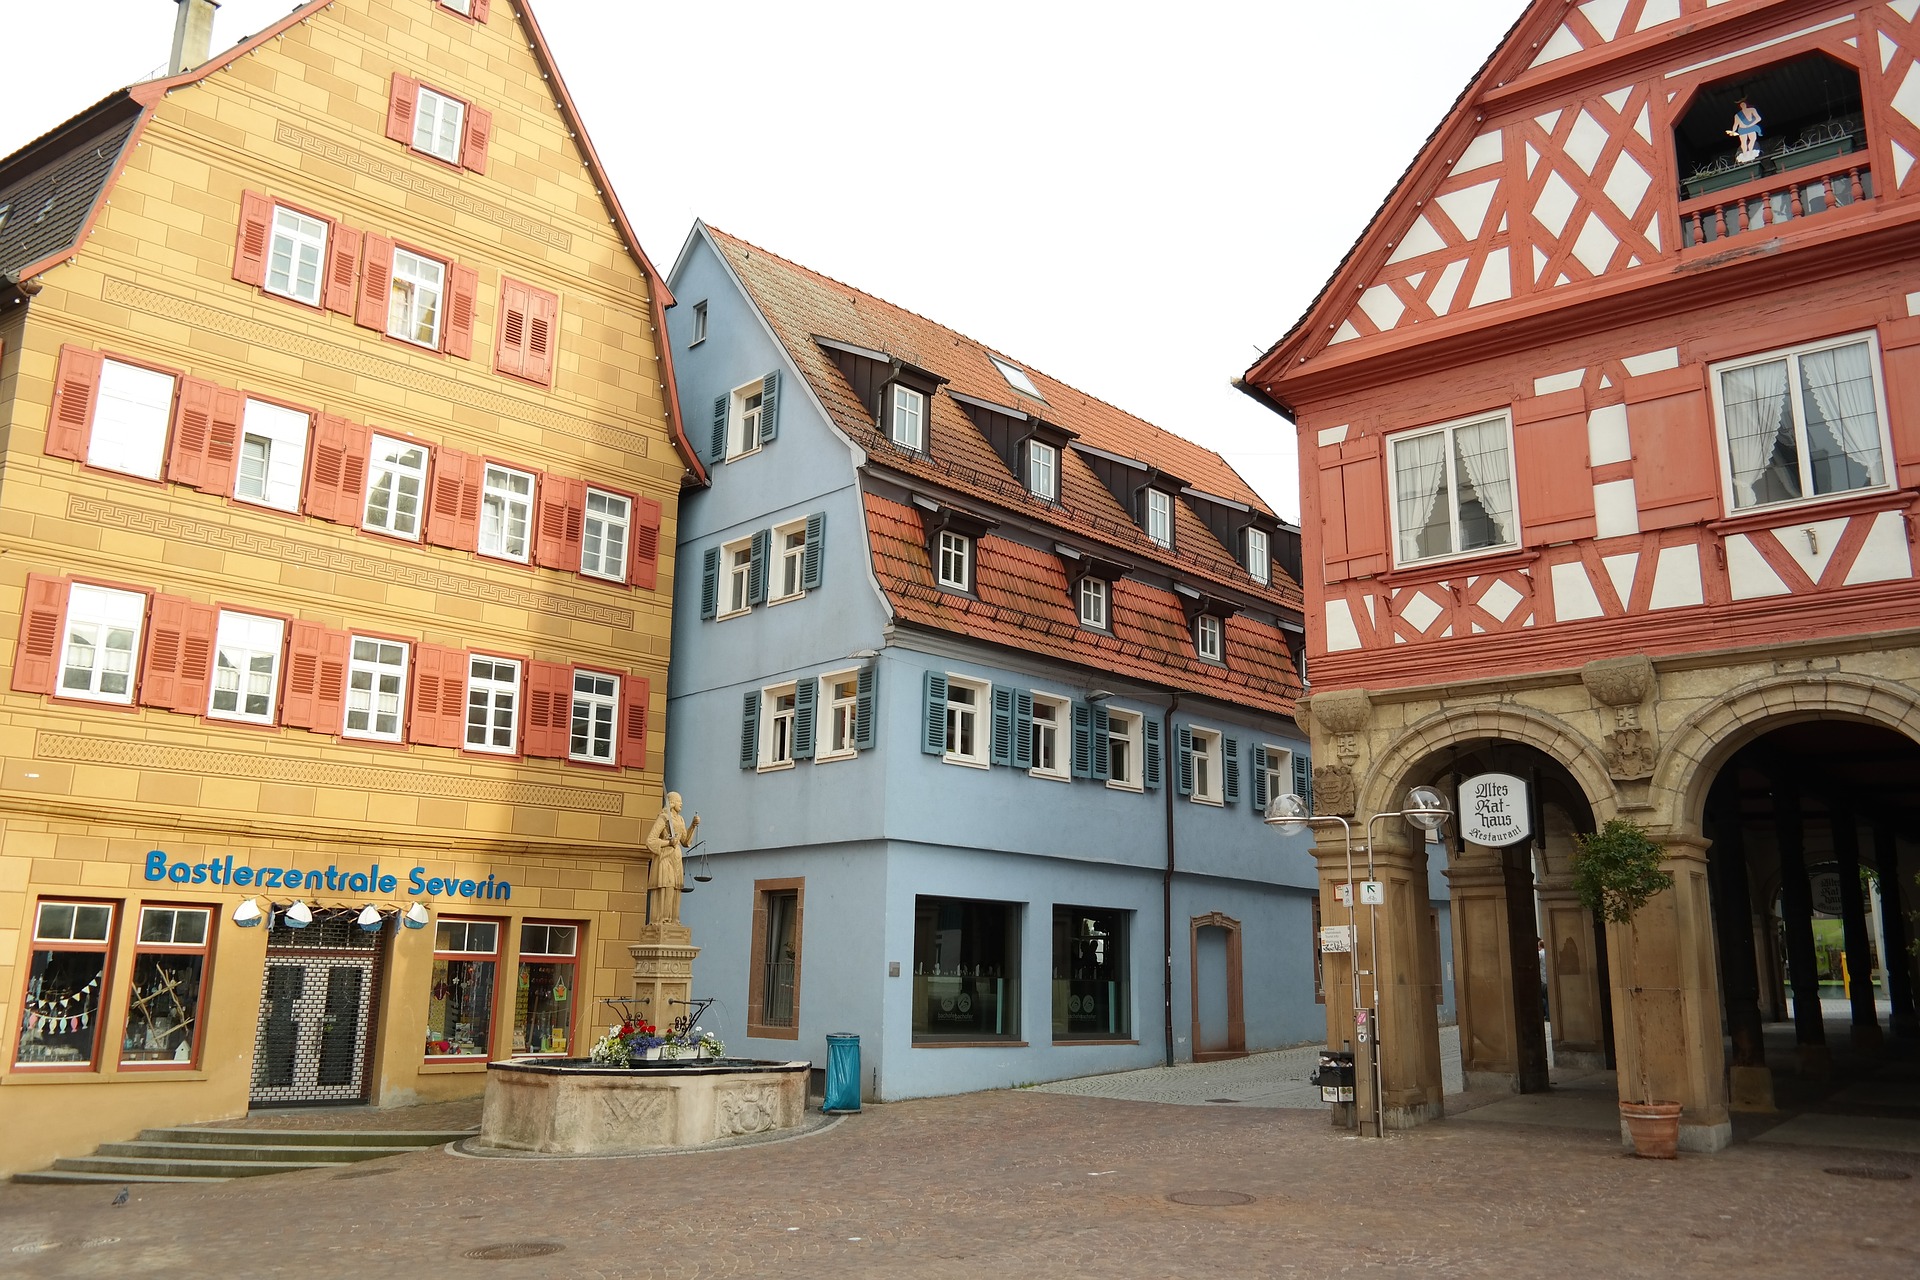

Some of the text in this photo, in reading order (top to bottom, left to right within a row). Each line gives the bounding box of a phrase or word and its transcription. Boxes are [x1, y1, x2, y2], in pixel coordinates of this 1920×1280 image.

[1474, 782, 1508, 798] Altes
[1474, 798, 1510, 816] Rat-
[1481, 814, 1512, 828] haus
[1468, 825, 1522, 842] Restaurant
[145, 850, 511, 899] Bastlerzentrale Severin
